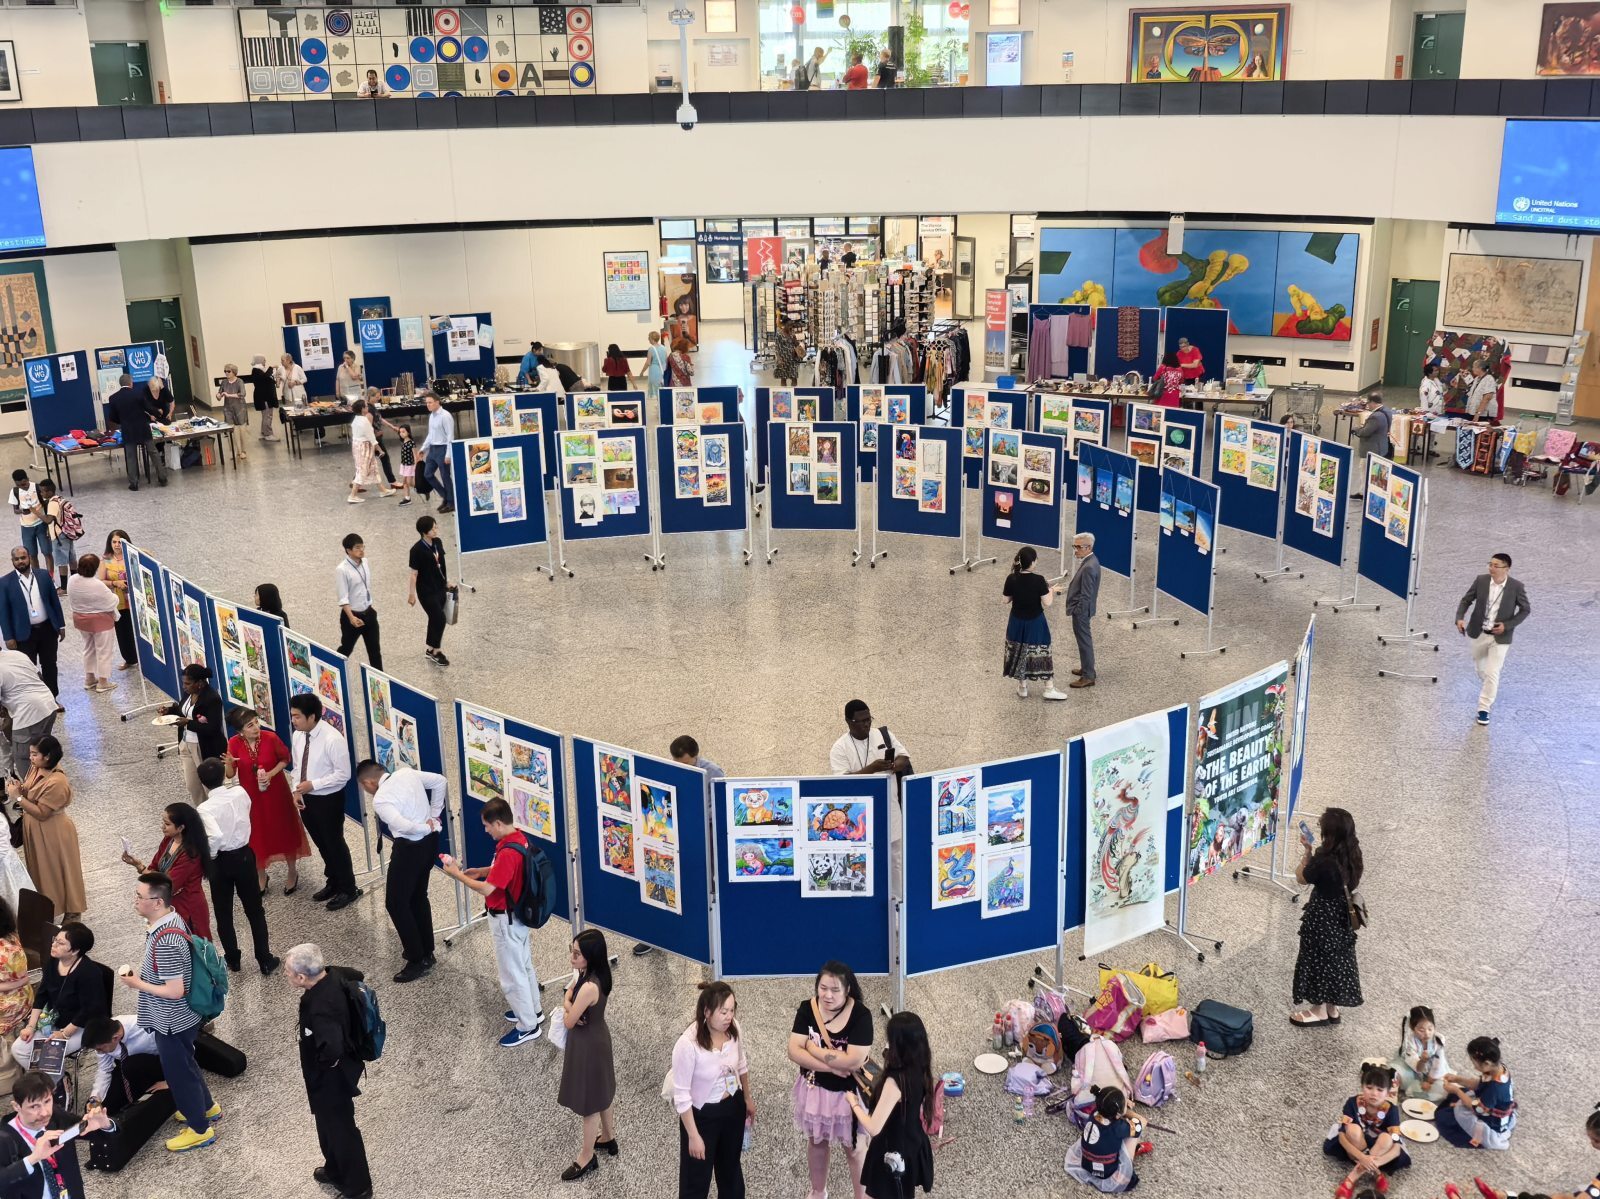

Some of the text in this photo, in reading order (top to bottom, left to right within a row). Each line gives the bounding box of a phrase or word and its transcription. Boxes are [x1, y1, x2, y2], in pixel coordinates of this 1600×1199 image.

[520, 63, 542, 88] A
[1512, 213, 1533, 222] sand
[1537, 215, 1553, 223] and
[1558, 217, 1578, 225] dust
[134, 350, 144, 358] UN
[34, 364, 44, 372] UN
[1207, 721, 1274, 758] SUSTAINABLE DEVELOPMENT GOALS
[1226, 720, 1257, 740] UNITED NATIONS
[1206, 735, 1269, 780] THE BEAUTY
[1205, 753, 1271, 798] OF THE EARTH
[1214, 777, 1258, 803] YOUTH ART EXHIBITION
